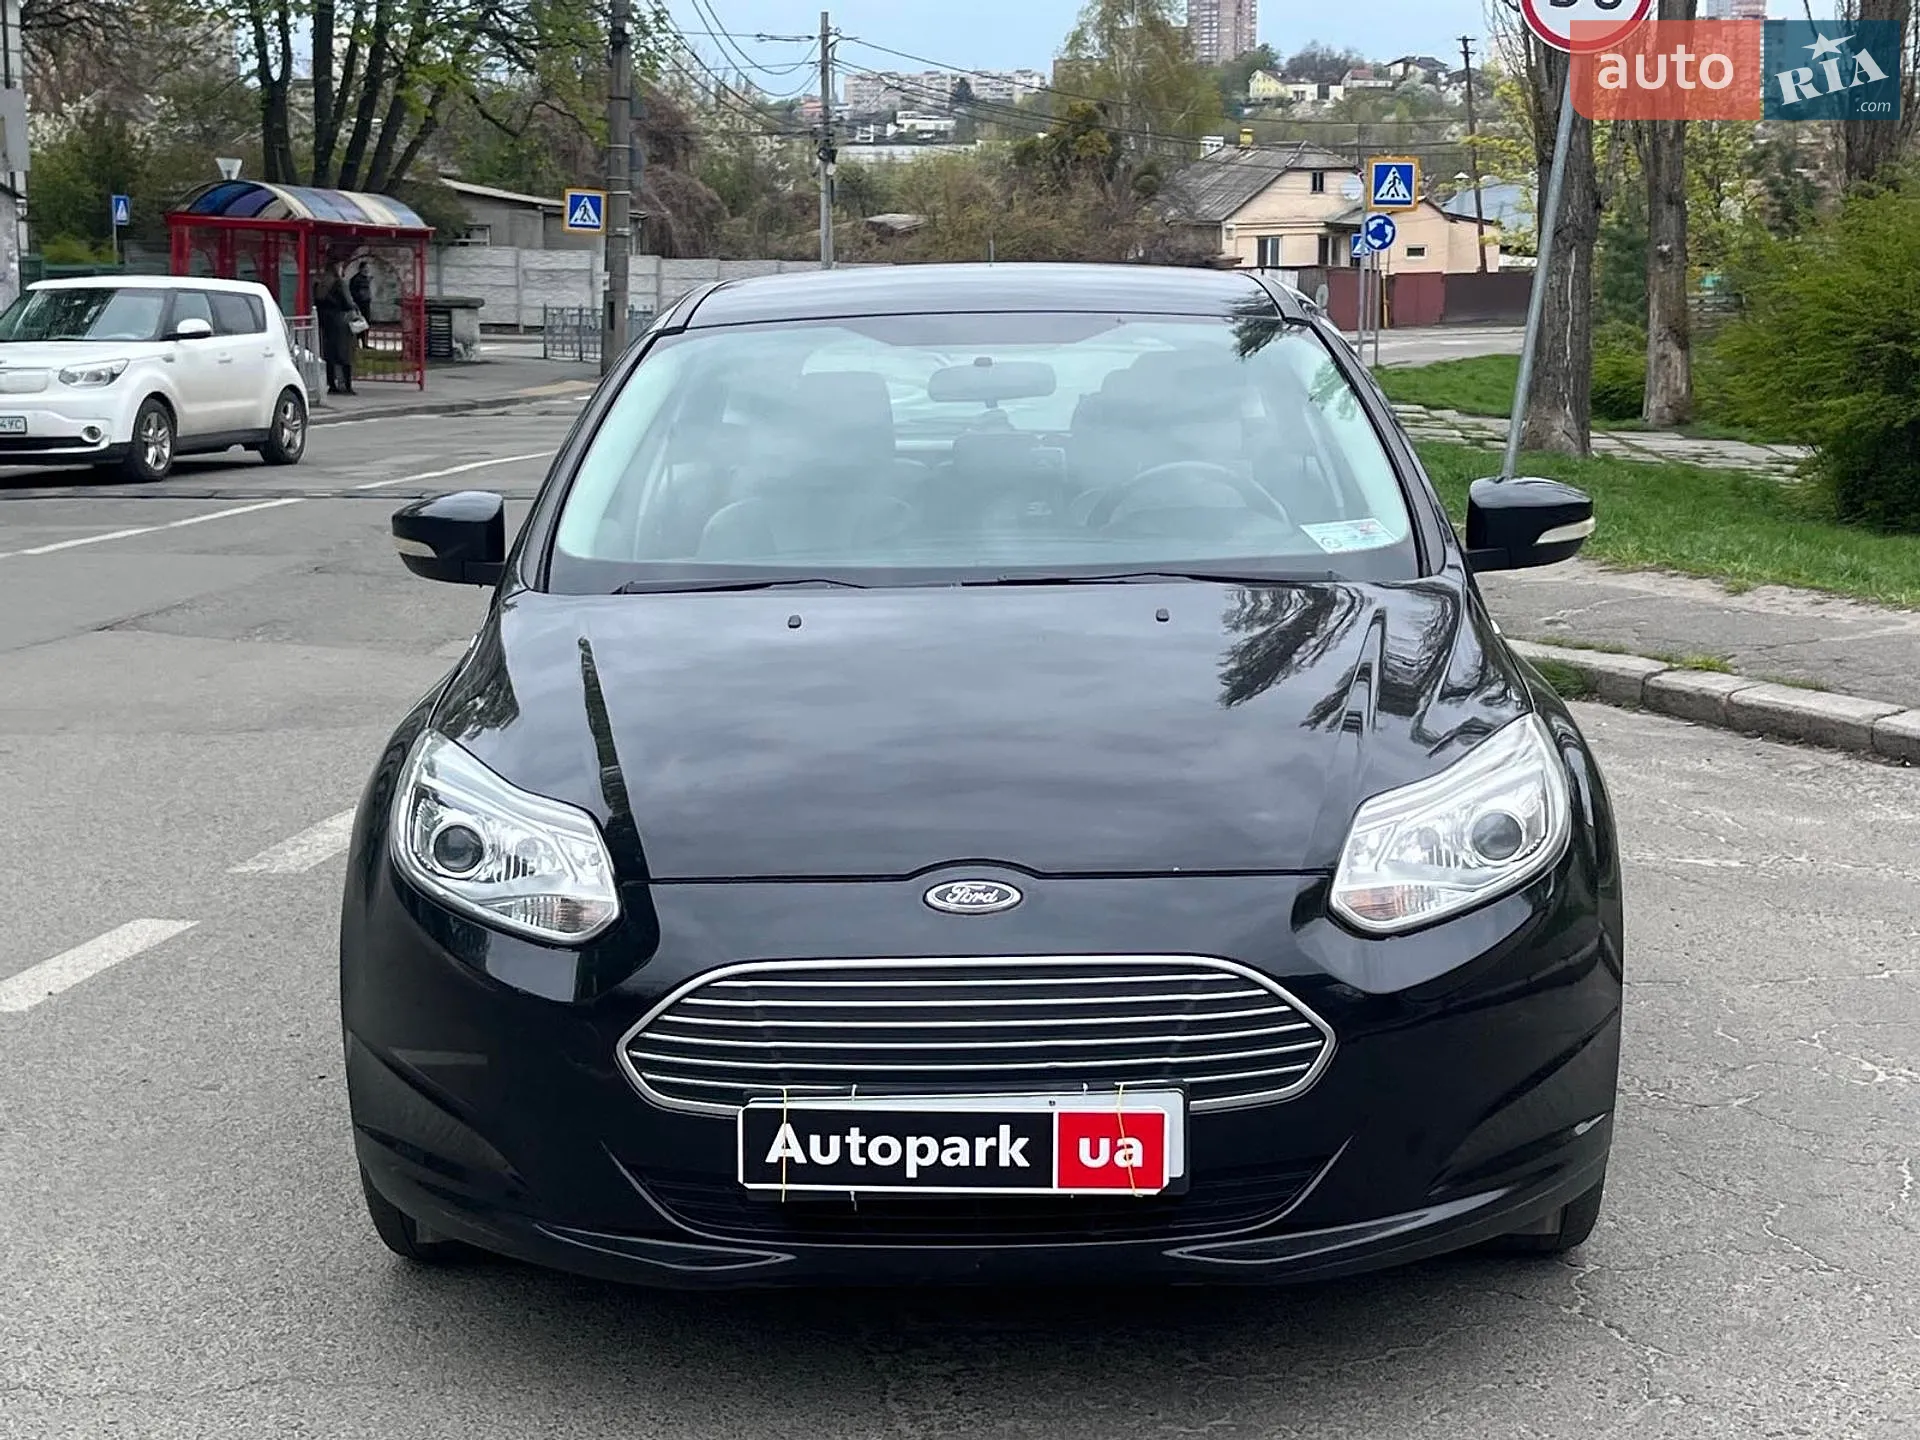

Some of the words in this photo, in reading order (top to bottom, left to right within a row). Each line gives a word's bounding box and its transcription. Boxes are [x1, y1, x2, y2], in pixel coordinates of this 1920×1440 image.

[945, 884, 999, 903] Ford
[765, 1123, 1031, 1178] Autopark
[1078, 1136, 1144, 1168] ua
